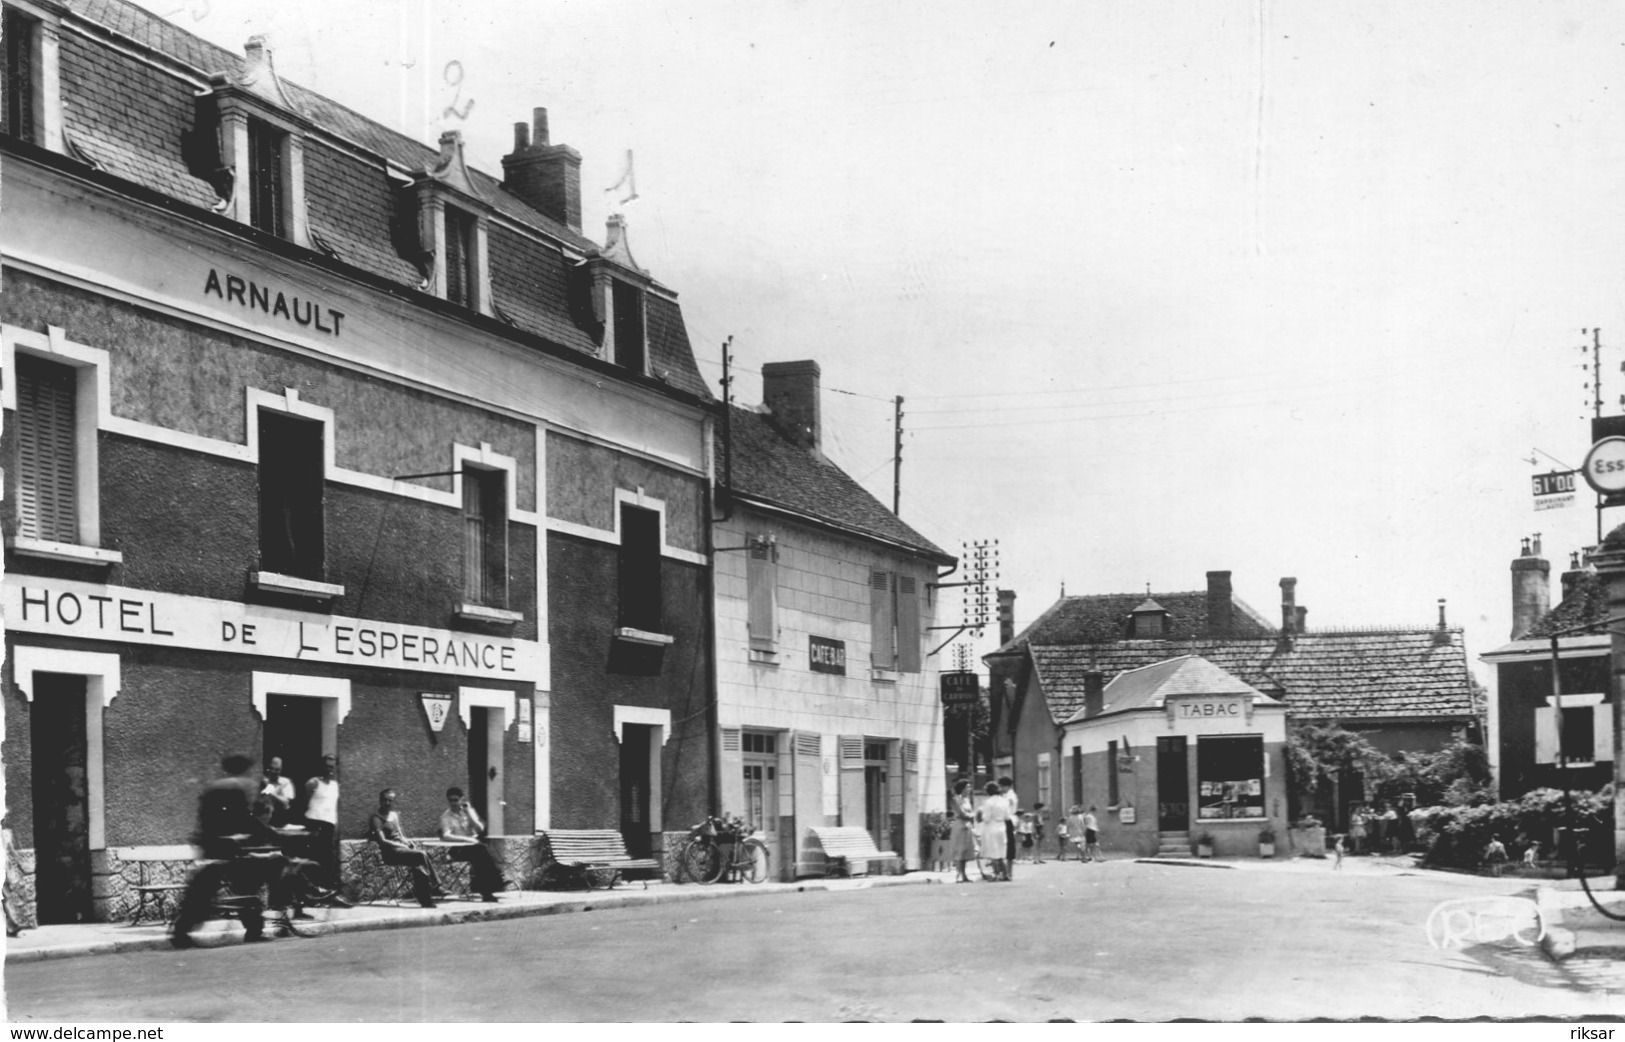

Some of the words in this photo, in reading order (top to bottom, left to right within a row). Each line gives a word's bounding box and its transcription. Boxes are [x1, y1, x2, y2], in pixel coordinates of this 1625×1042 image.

[443, 59, 475, 120] 2
[204, 268, 346, 337] ARNAULT
[21, 585, 174, 637] HOTEL
[222, 620, 257, 646] DE
[298, 621, 517, 673] L'ESPERANCE
[1180, 703, 1239, 717] TABAC
